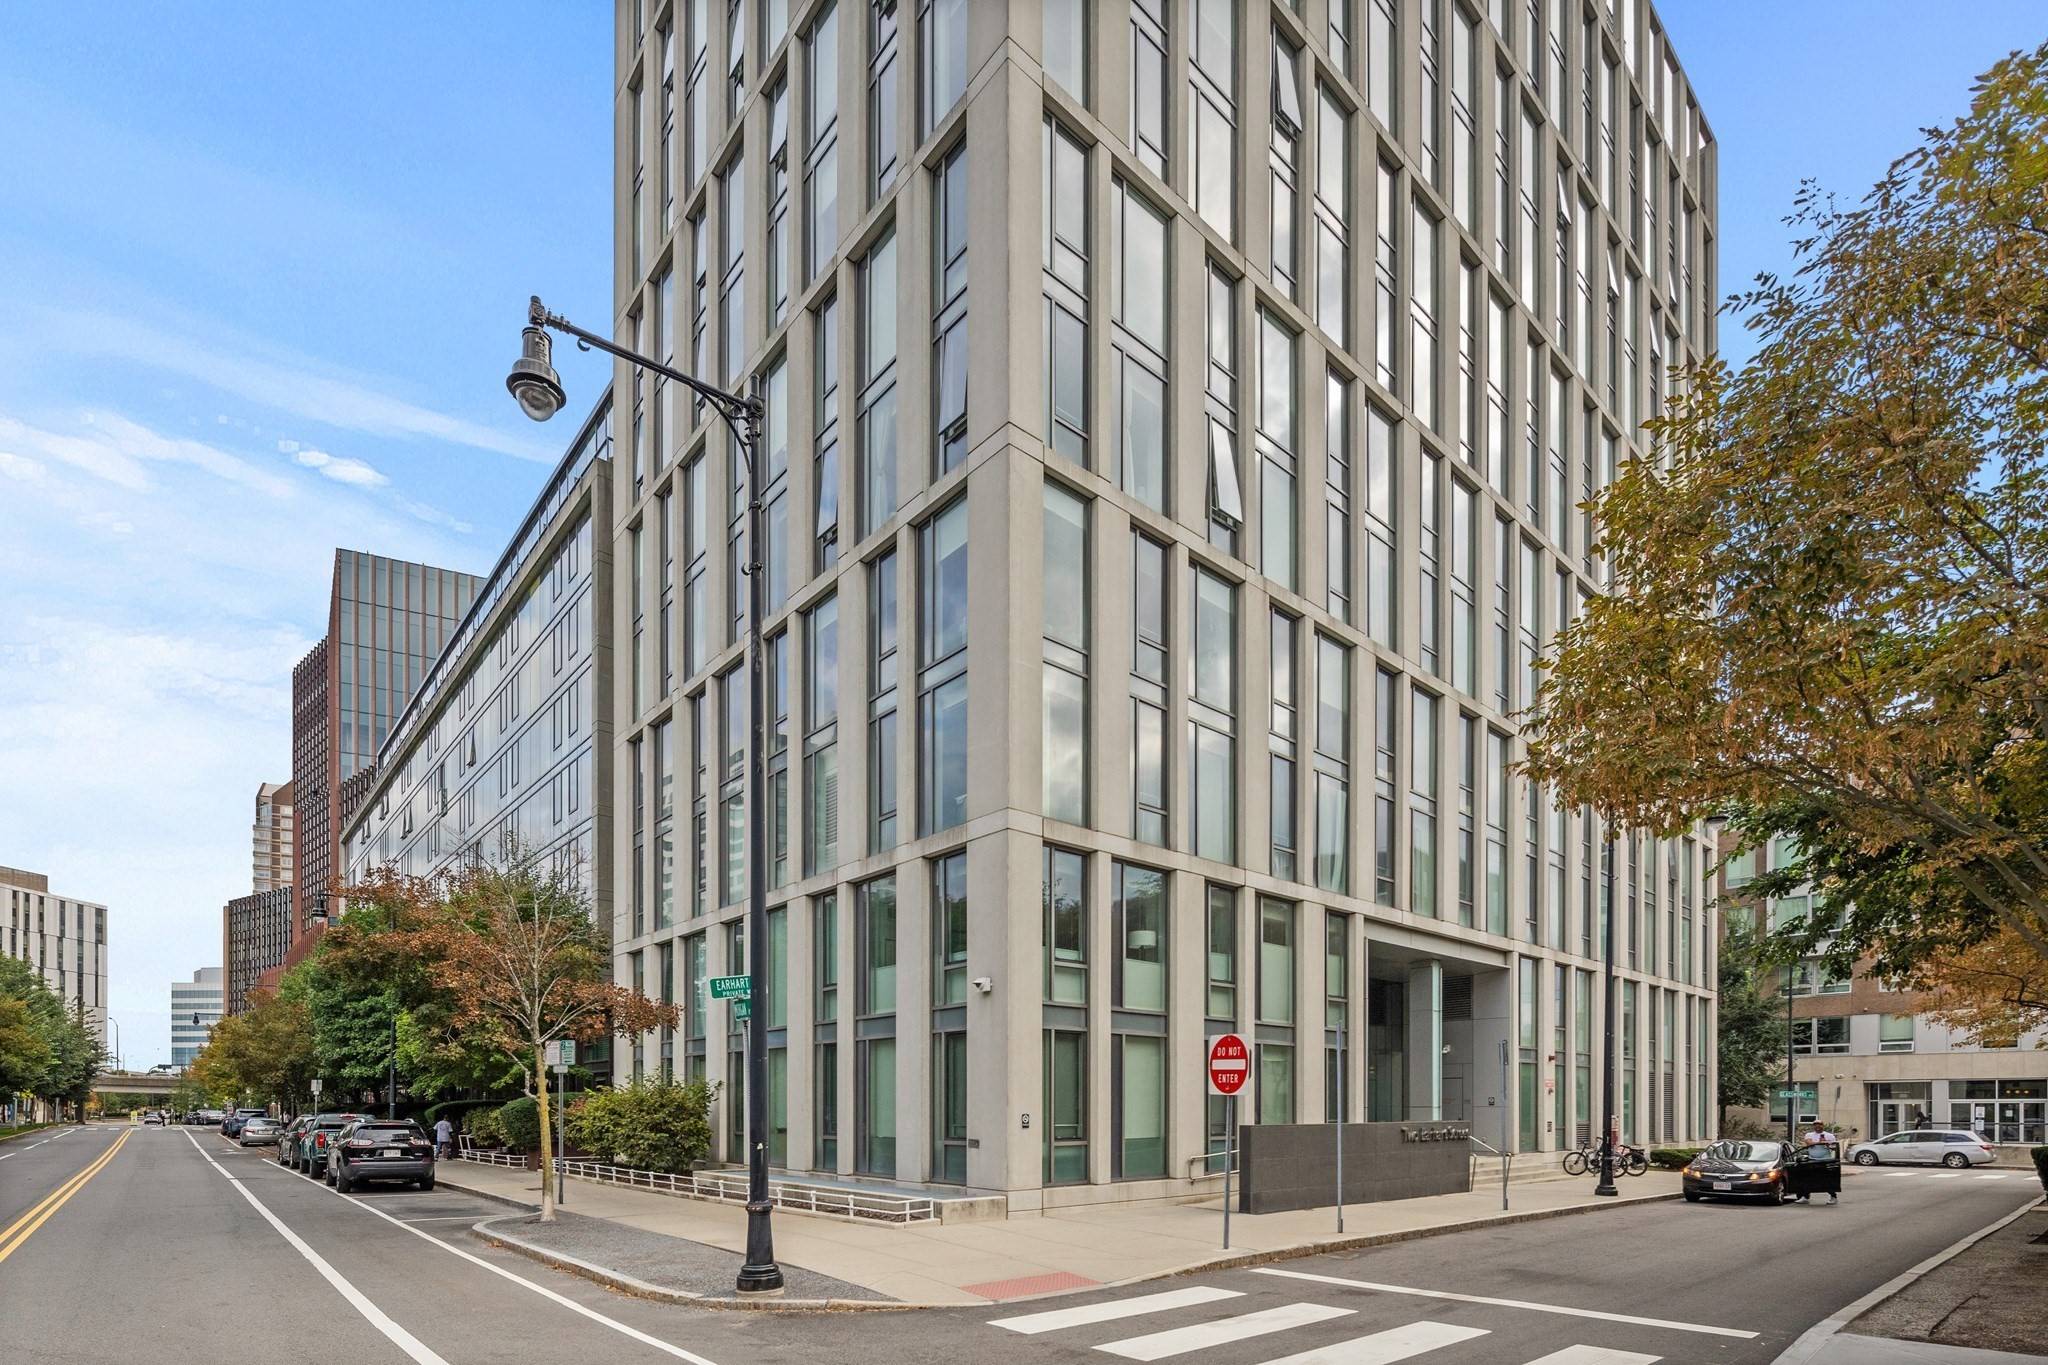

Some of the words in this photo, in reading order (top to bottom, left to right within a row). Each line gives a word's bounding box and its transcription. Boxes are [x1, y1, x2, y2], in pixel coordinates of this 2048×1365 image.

[716, 977, 749, 991] EARHART
[722, 989, 744, 997] PRIVATE
[1217, 1047, 1226, 1056] DO
[1228, 1046, 1241, 1056] NOT
[1218, 1073, 1239, 1083] ENTER
